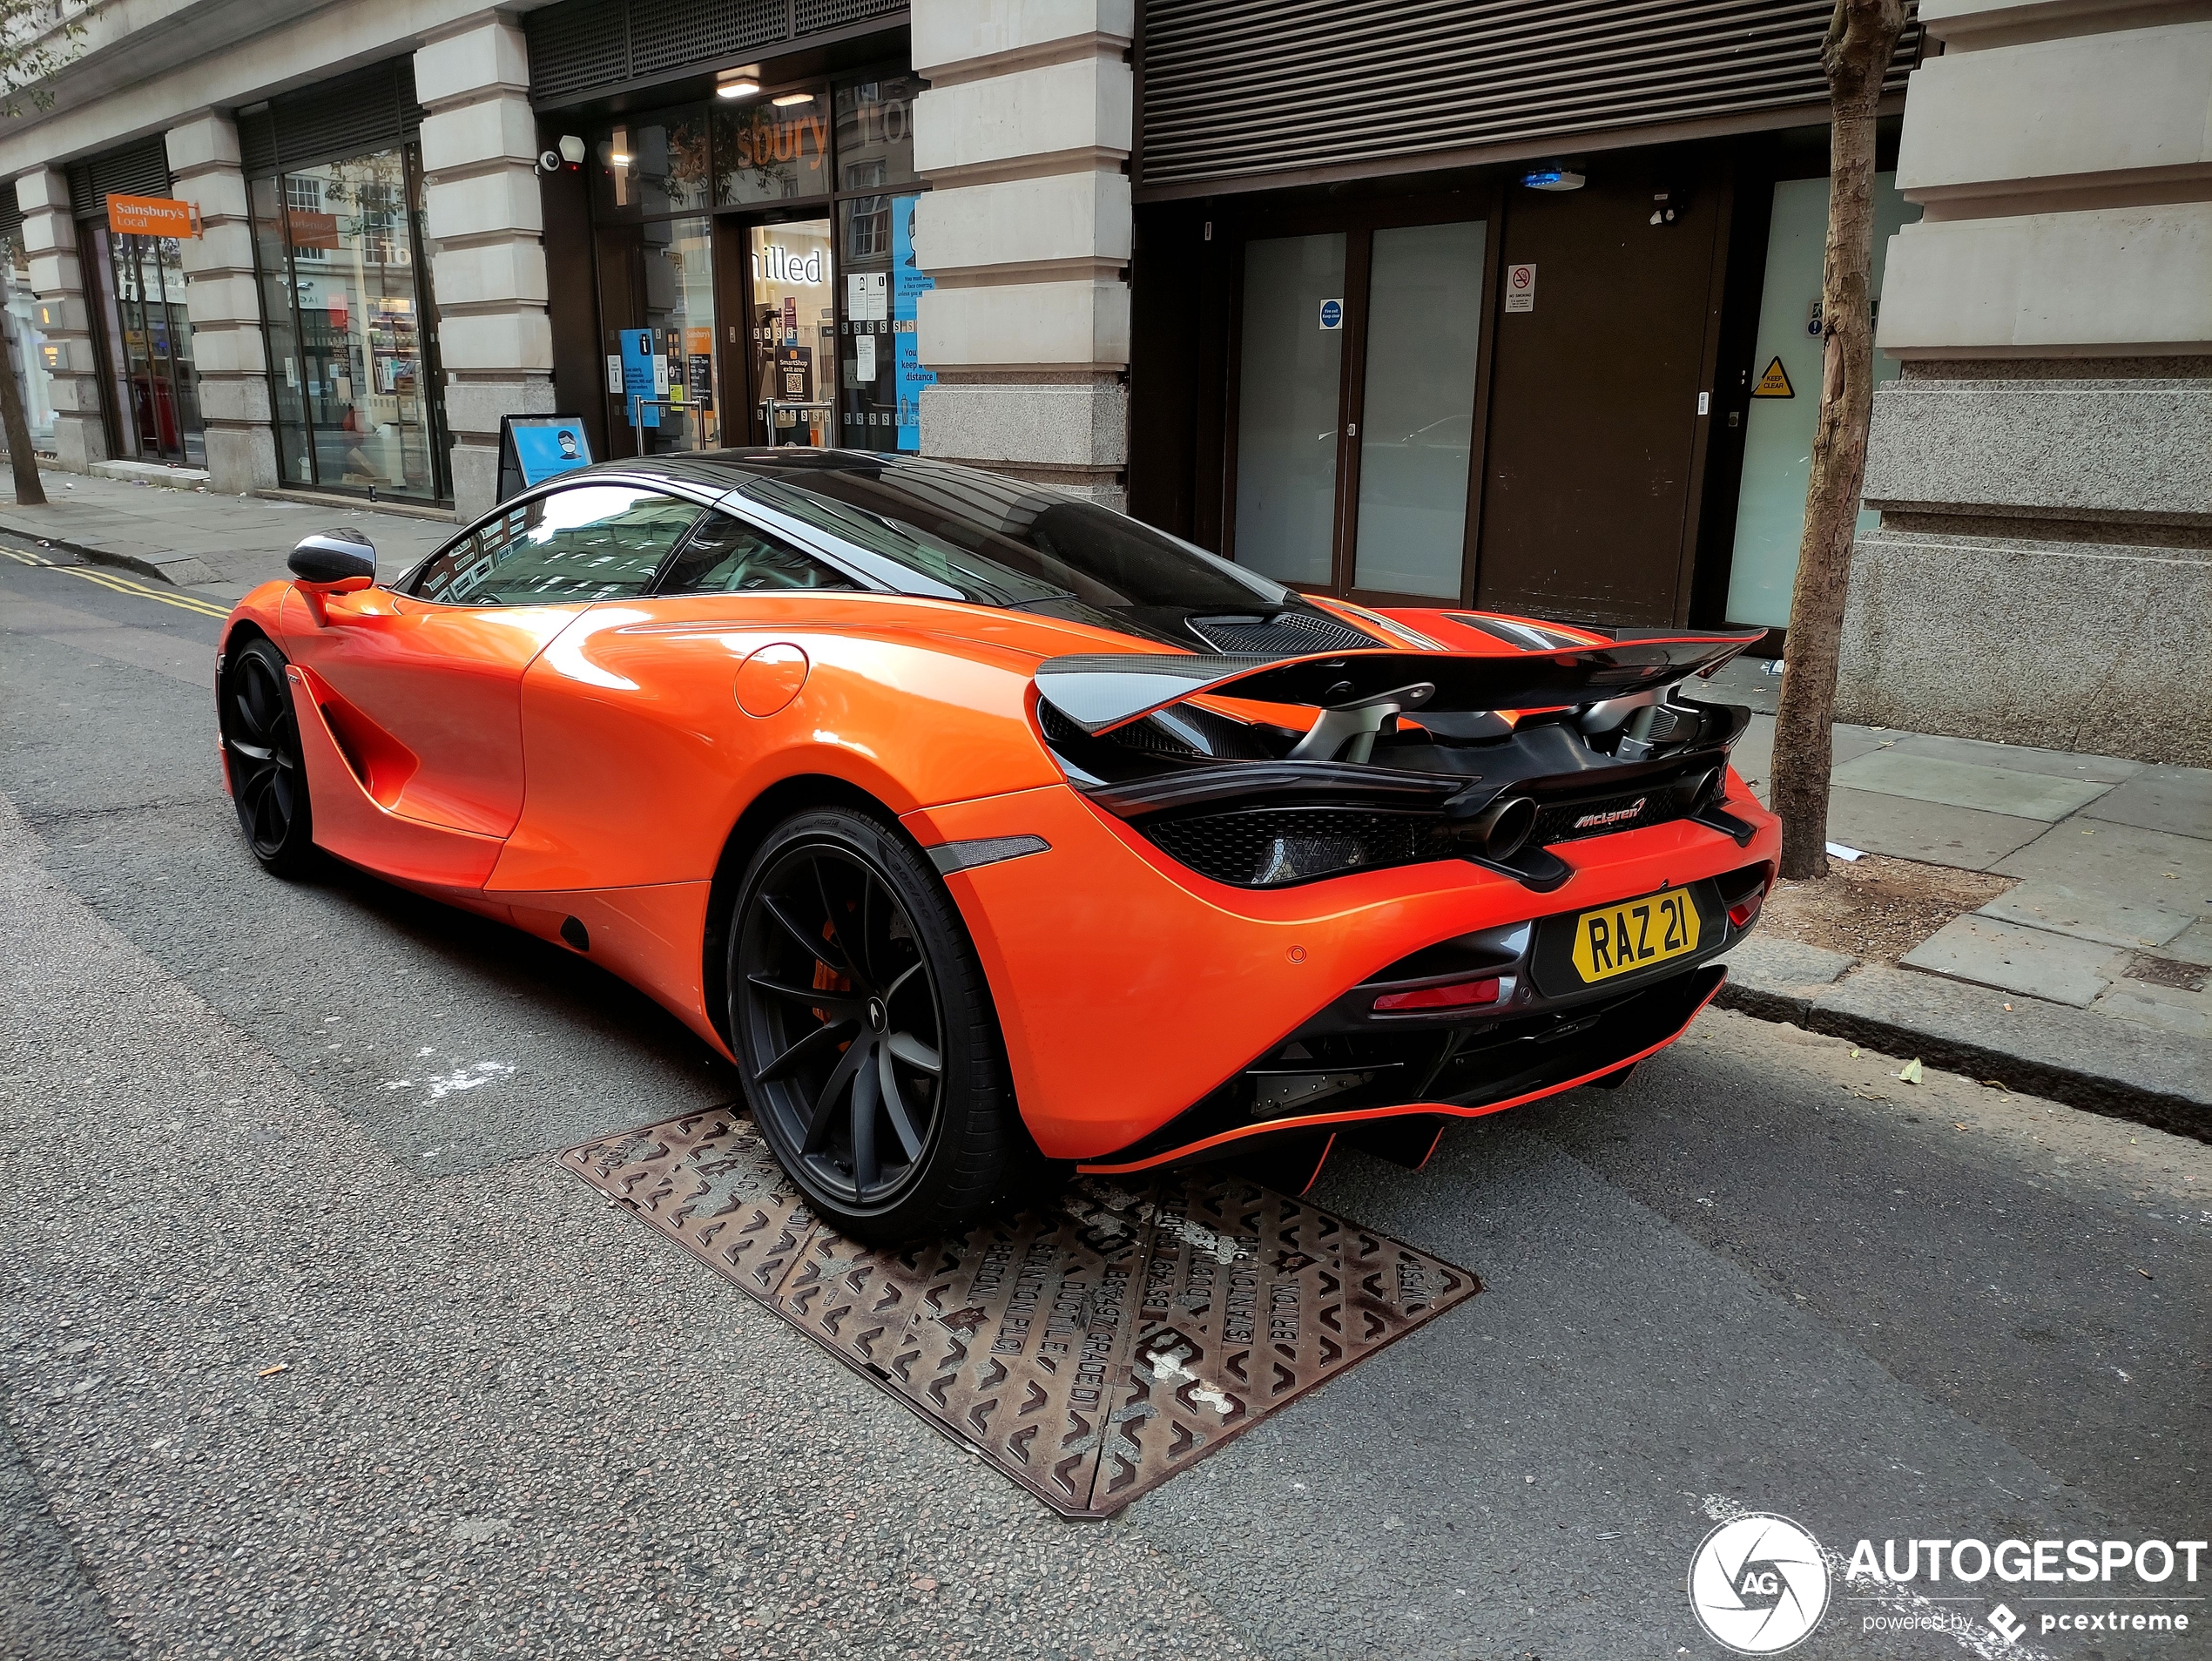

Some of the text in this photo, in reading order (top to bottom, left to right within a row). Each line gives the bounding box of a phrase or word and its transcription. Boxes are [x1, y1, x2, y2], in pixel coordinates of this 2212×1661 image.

[115, 202, 185, 219] Sainsbury's
[117, 215, 148, 227] Local
[900, 360, 917, 371] keep
[904, 348, 917, 357] You
[906, 372, 934, 381] distance
[1574, 807, 1639, 828] McLaren
[1588, 895, 1689, 974] RAZ 21
[967, 1244, 1015, 1300] BRITON
[993, 1242, 1060, 1353] STANTON PLC
[1223, 1267, 1257, 1344] STANTON
[1270, 1284, 1300, 1343] BRITON
[1037, 1280, 1087, 1355] DUCTILE
